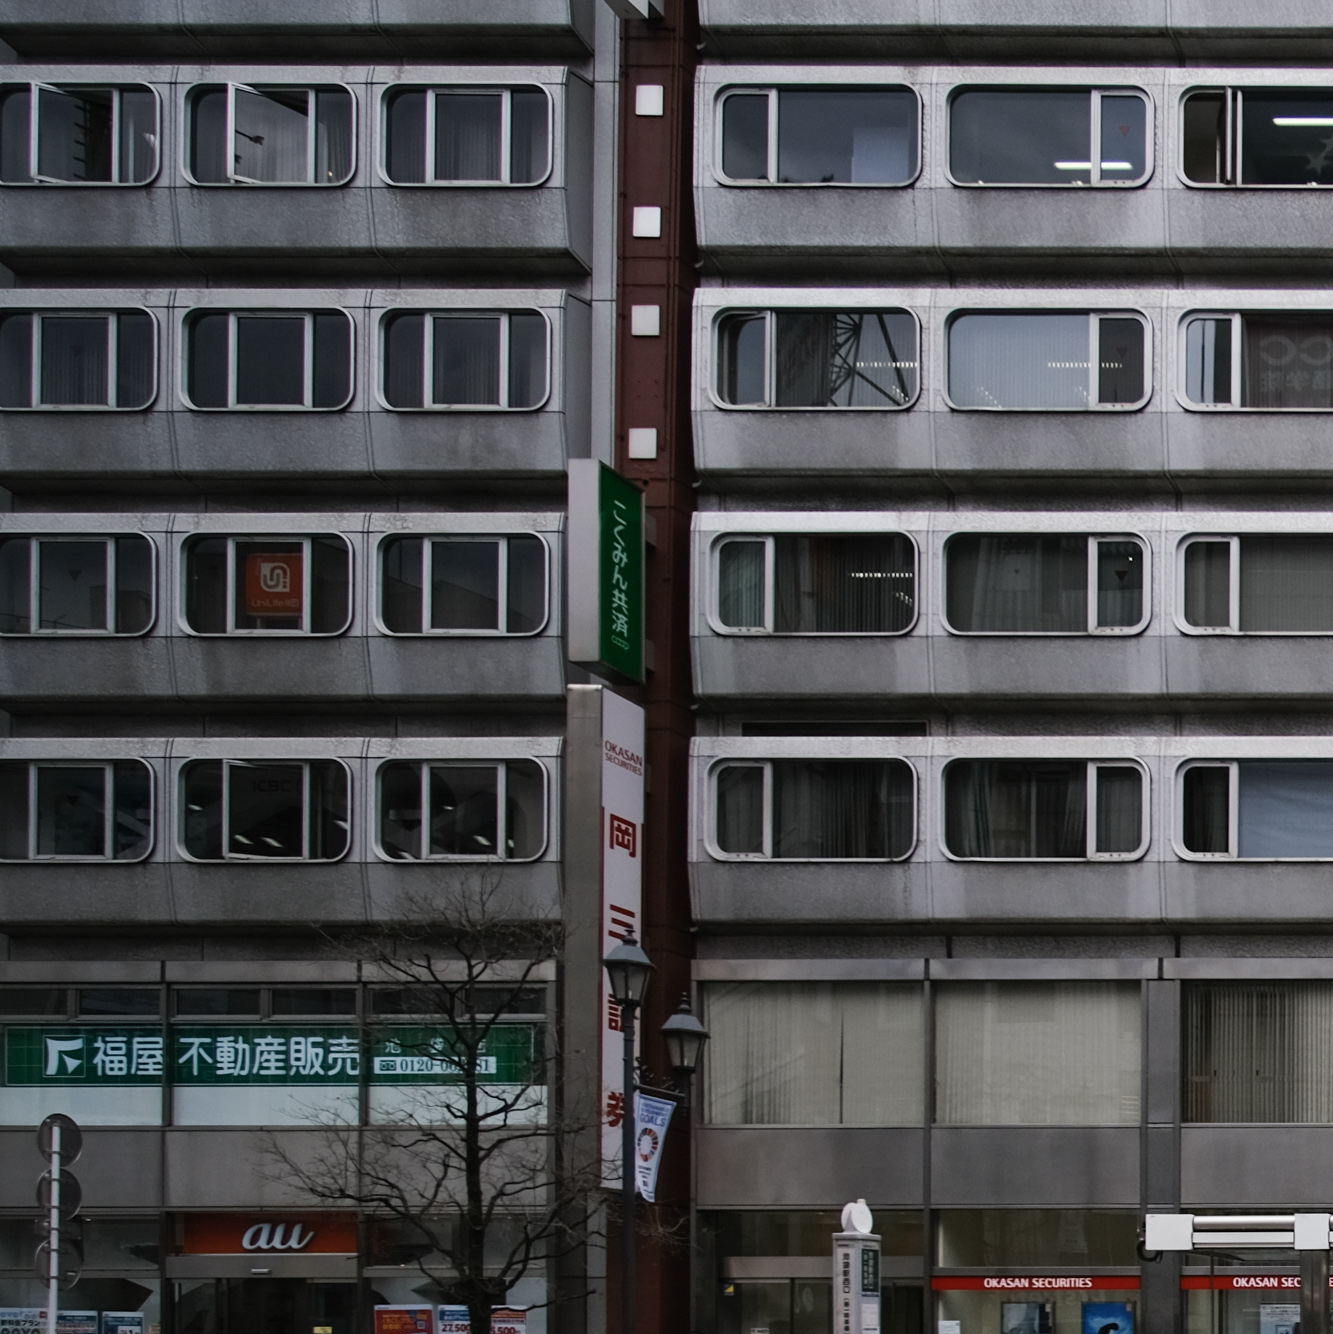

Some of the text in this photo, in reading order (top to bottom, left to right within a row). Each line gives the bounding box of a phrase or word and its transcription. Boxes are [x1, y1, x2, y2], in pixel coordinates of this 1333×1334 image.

[612, 500, 629, 637] こくみん共済
[605, 740, 643, 767] OKASAN
[605, 753, 643, 777] SECURITIES
[242, 1223, 315, 1250] au
[984, 1278, 1092, 1288] OKASAN SECURITIES
[1233, 1277, 1278, 1287] OKASAN
